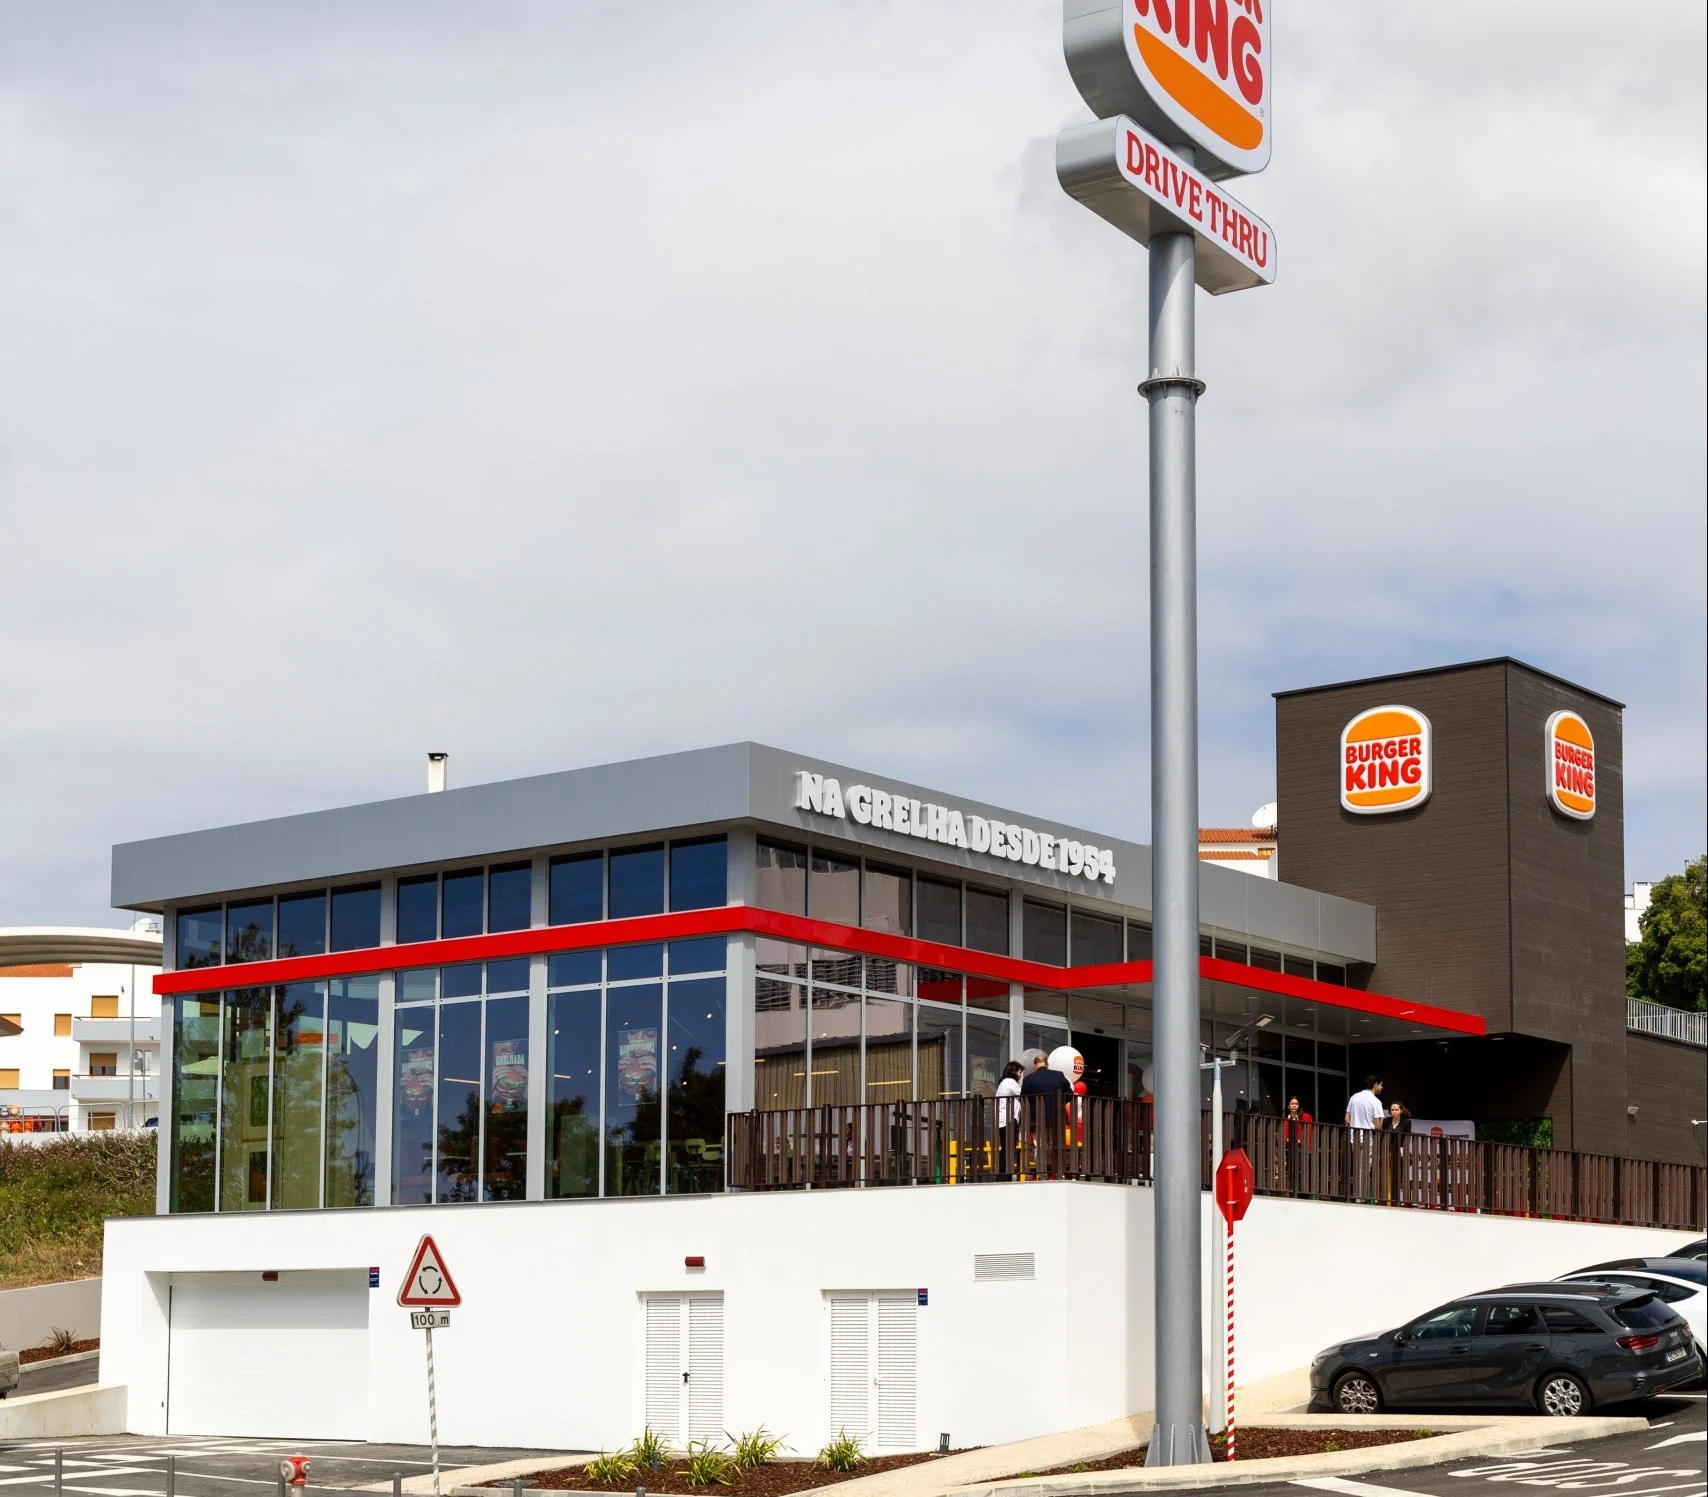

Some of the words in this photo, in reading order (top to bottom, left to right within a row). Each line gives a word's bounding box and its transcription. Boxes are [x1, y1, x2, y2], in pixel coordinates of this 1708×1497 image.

[1126, 130, 1203, 223] DRIVE
[1206, 189, 1268, 268] THRU
[1346, 737, 1421, 764] BURGER
[1555, 741, 1593, 771] BURGER
[1346, 757, 1421, 791] KING
[1555, 761, 1594, 797] KING
[797, 770, 846, 819] NA
[847, 784, 968, 849] GRELHA
[968, 815, 1055, 870] DESDE
[1055, 838, 1116, 884] 1954
[414, 1314, 435, 1326] 100
[440, 1315, 449, 1325] m
